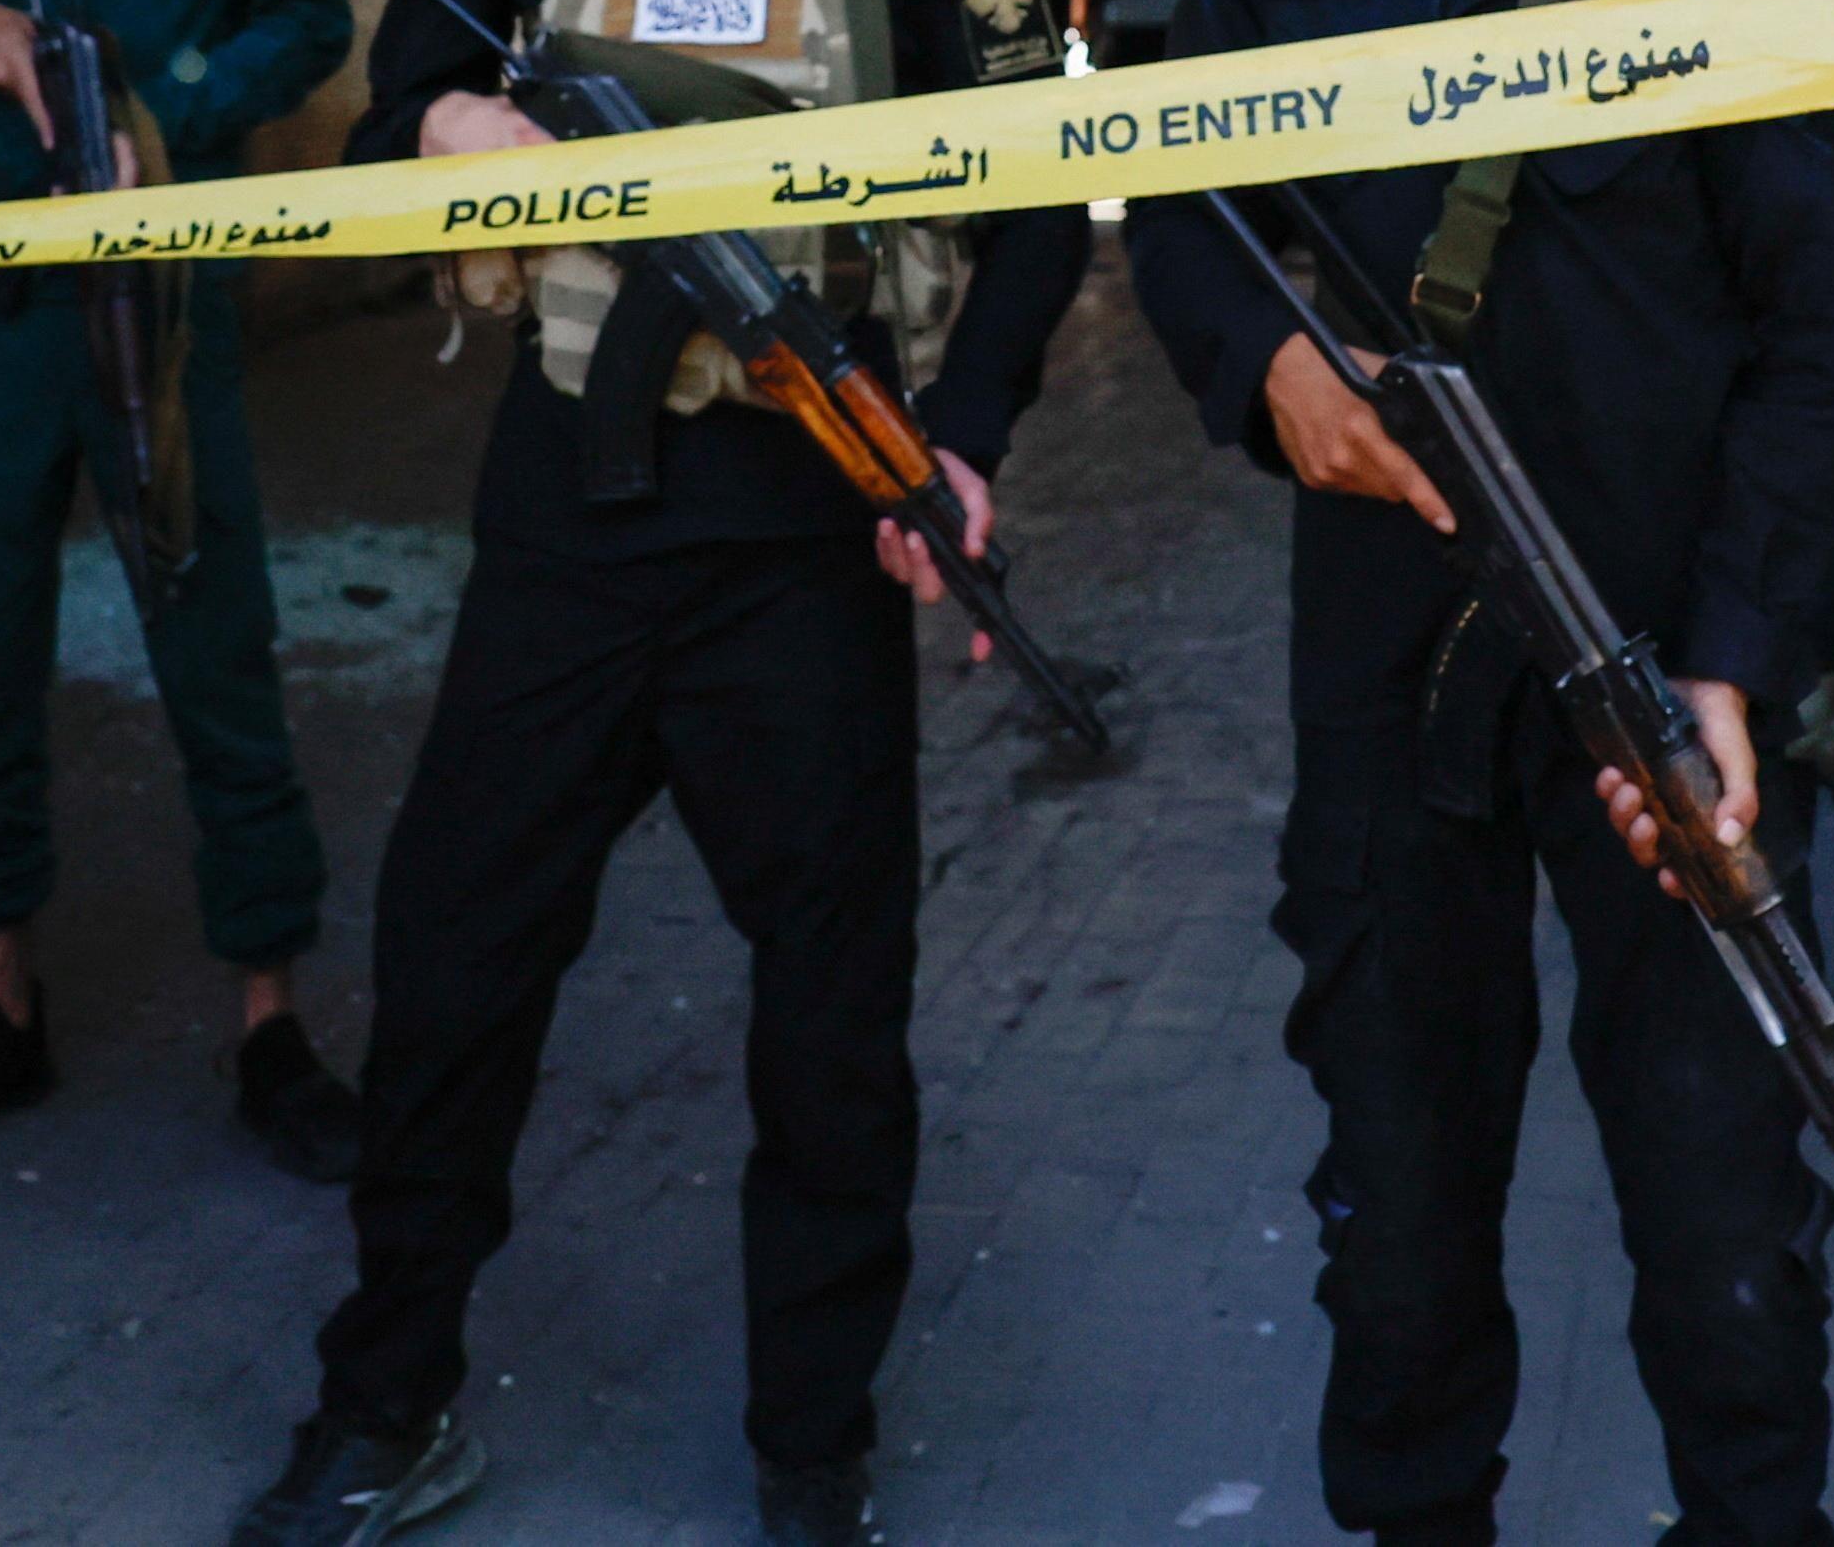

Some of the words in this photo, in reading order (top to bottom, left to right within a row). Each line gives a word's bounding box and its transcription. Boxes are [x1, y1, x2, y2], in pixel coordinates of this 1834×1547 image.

[1407, 50, 1569, 126] الدخول
[1585, 28, 1710, 104] ممنوع
[1060, 113, 1139, 159] NO
[1159, 84, 1341, 147] ENTRY
[442, 180, 652, 233] POLICE
[771, 137, 988, 206] الشرطة
